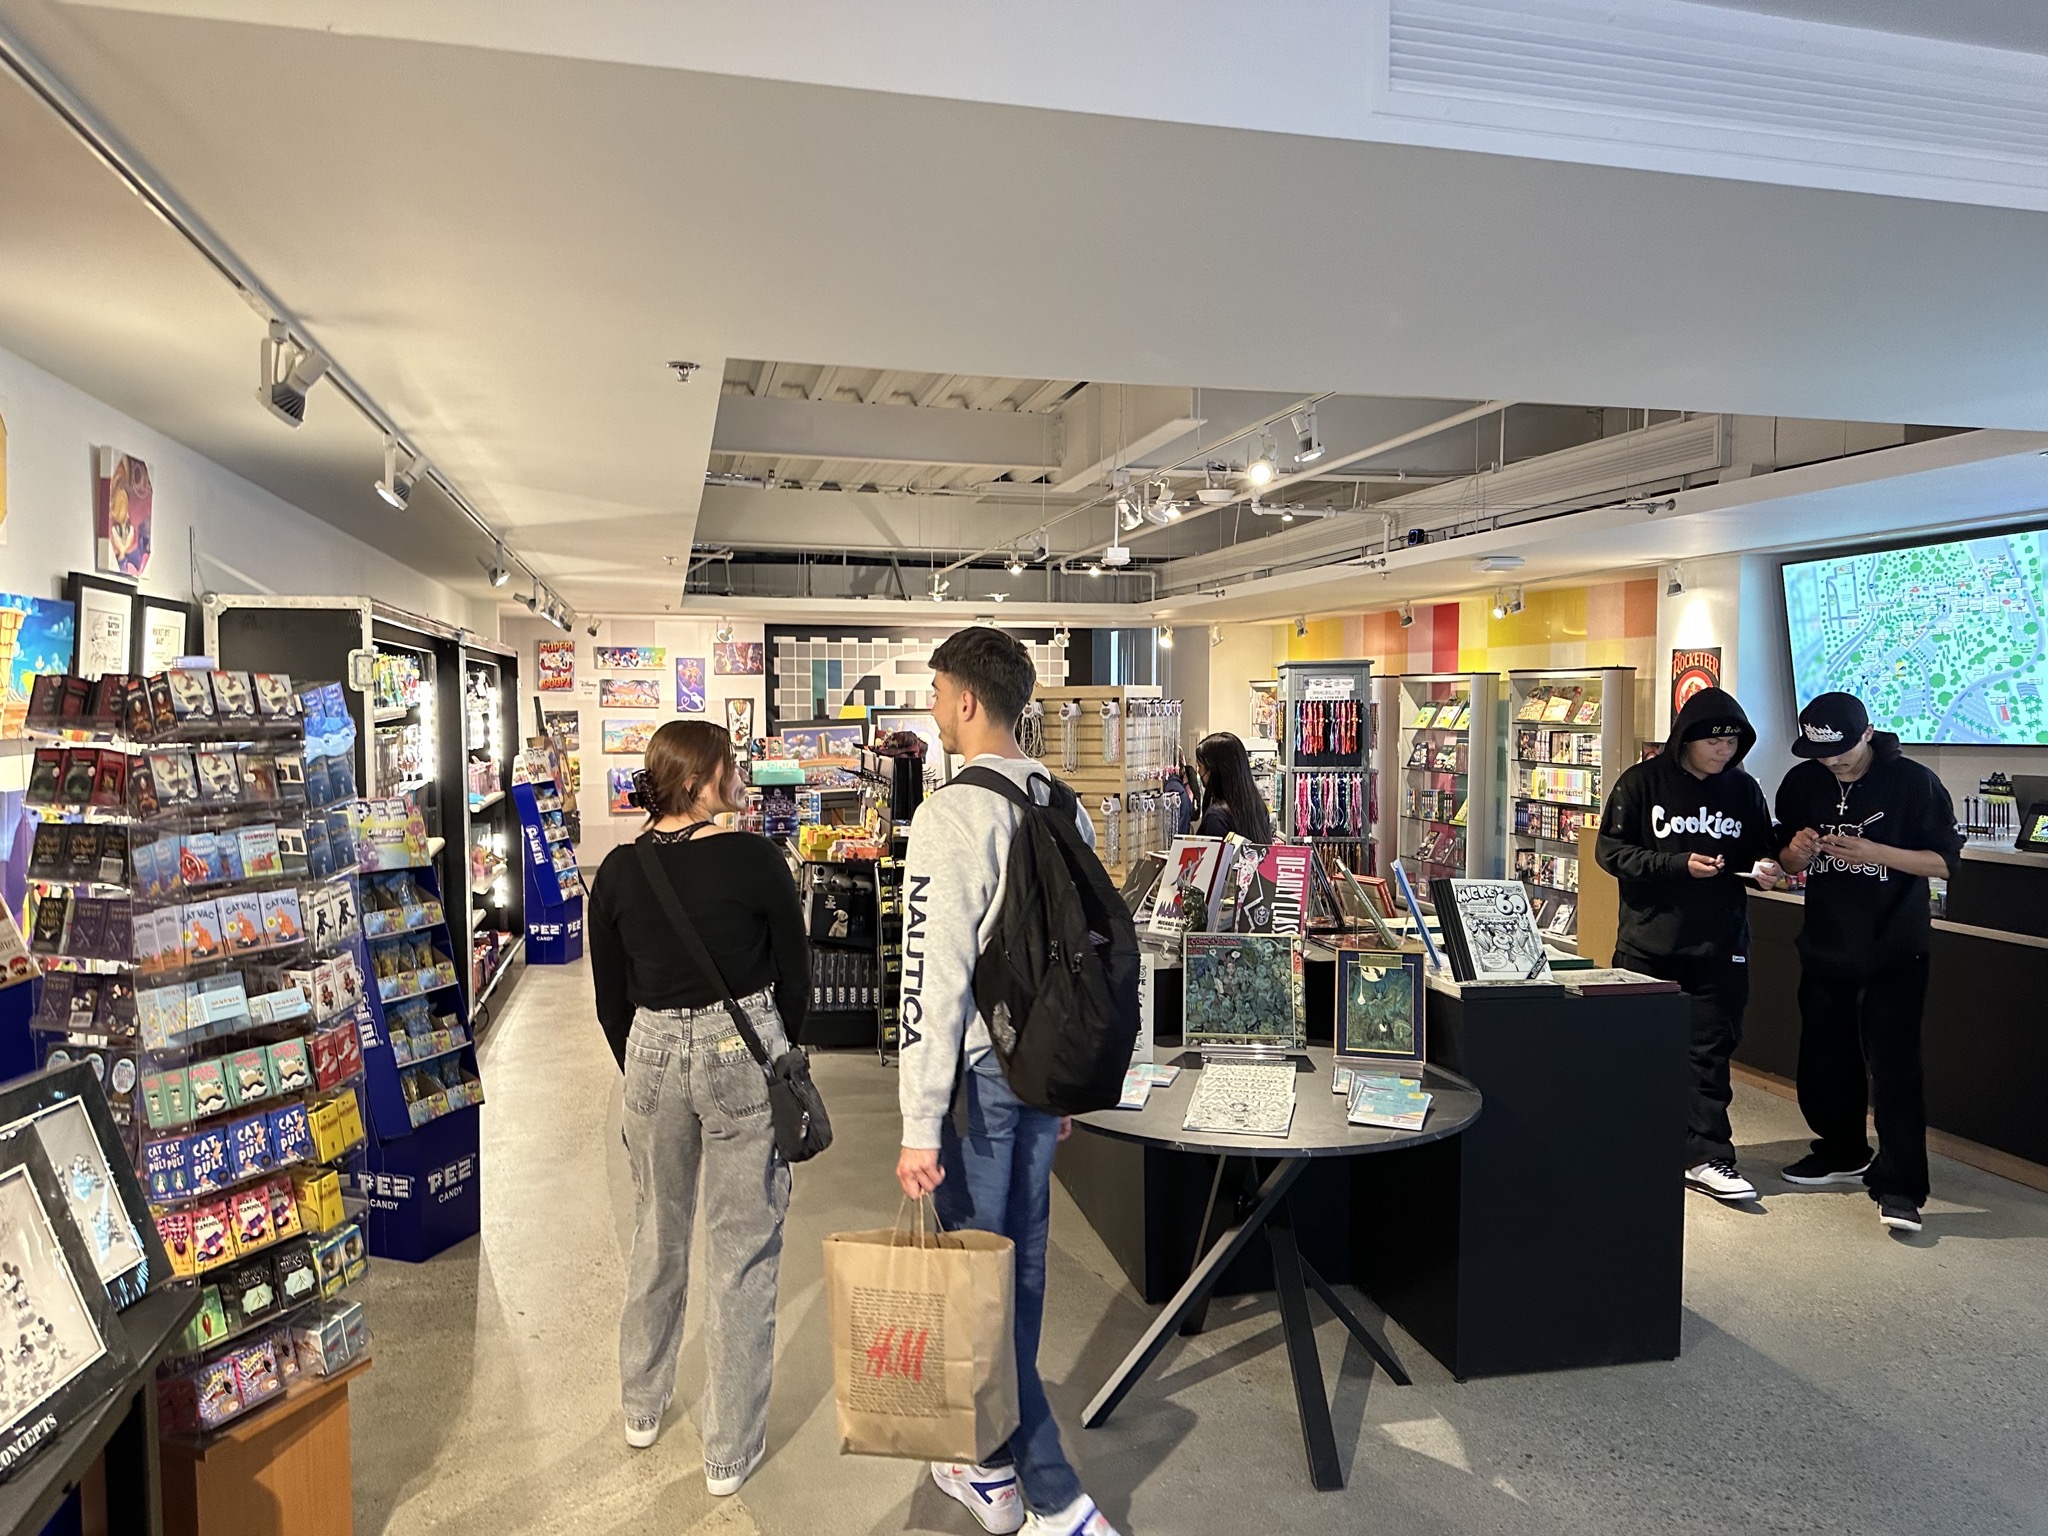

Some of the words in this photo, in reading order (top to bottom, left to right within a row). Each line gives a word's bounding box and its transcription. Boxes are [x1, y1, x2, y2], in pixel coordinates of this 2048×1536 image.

[1672, 652, 1719, 681] ROCKETEER
[1651, 805, 1742, 839] Cookies
[525, 825, 548, 866] PEZ
[1275, 856, 1307, 902] DEADLY
[265, 899, 280, 910] CAT
[281, 897, 296, 907] VAC
[1456, 885, 1505, 904] MICKEY
[180, 911, 196, 924] CAT
[198, 909, 215, 919] VAC
[225, 904, 240, 915] CAT
[242, 901, 257, 911] VAC
[529, 924, 561, 935] PEZ
[567, 919, 582, 934] PEZ
[900, 875, 931, 1050] NAUTICA
[278, 1110, 300, 1130] CAT
[237, 1120, 260, 1142] CAT
[280, 1127, 306, 1152] PULT
[148, 1144, 162, 1158] CAT
[165, 1141, 180, 1155] CAT
[193, 1135, 217, 1157] CAT
[239, 1138, 267, 1164] PULT
[149, 1158, 167, 1174] PULT
[167, 1155, 185, 1170] PULT
[194, 1154, 223, 1180] PULT
[357, 1172, 410, 1199] PEZ
[428, 1158, 472, 1195] PEZ
[369, 1199, 399, 1211] CANDY
[438, 1185, 463, 1204] CANDY
[0, 1412, 58, 1471] ONCEPTS
